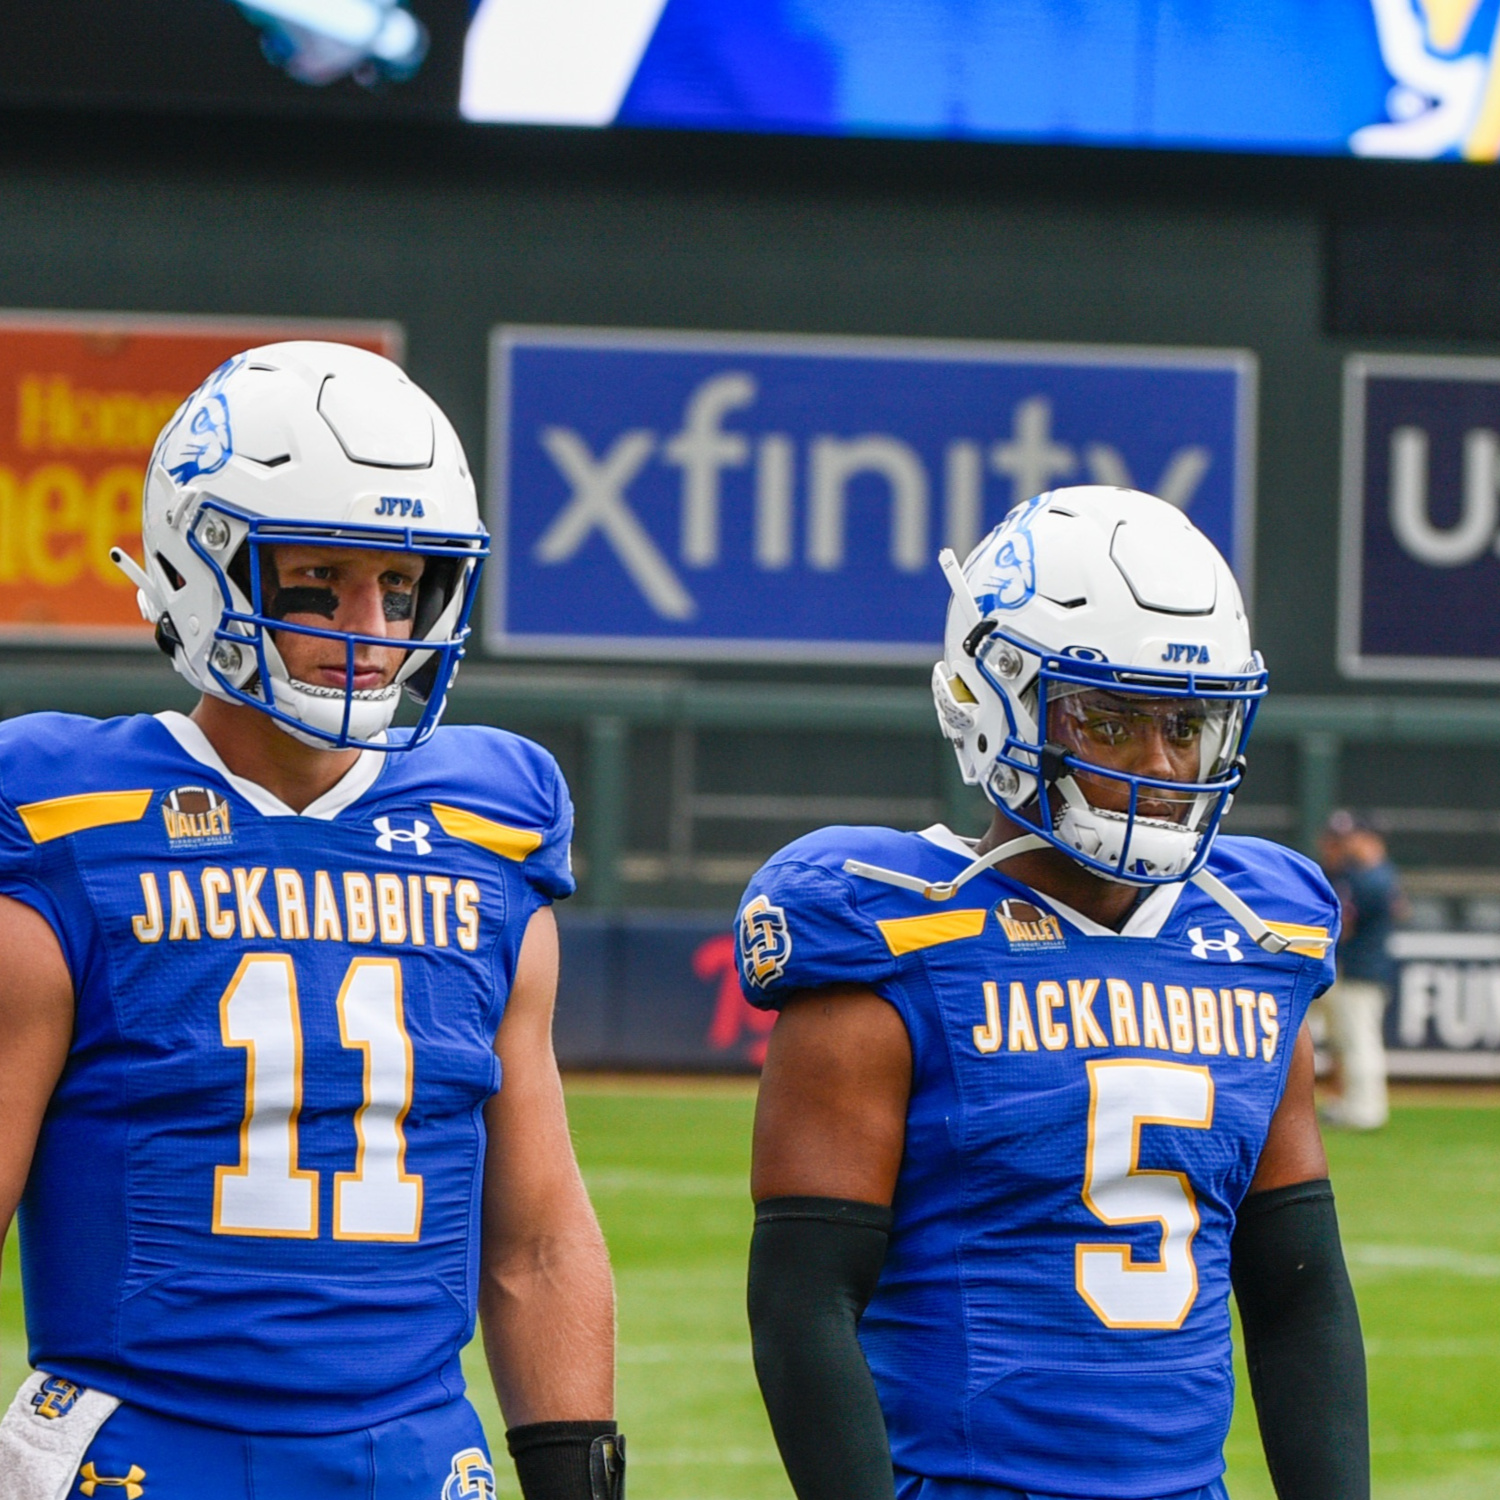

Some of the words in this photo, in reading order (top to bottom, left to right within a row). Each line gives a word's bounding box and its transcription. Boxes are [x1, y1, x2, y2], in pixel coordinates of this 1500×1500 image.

[374, 496, 425, 518] JFPA
[1161, 642, 1210, 664] JFPA
[161, 800, 231, 839] VALLEY
[131, 867, 481, 950] JACKRABBITS
[994, 911, 1064, 942] VALLEY
[973, 979, 1279, 1062] JACKRABBITS
[212, 953, 423, 1242] 11
[1075, 1058, 1214, 1329] 5
